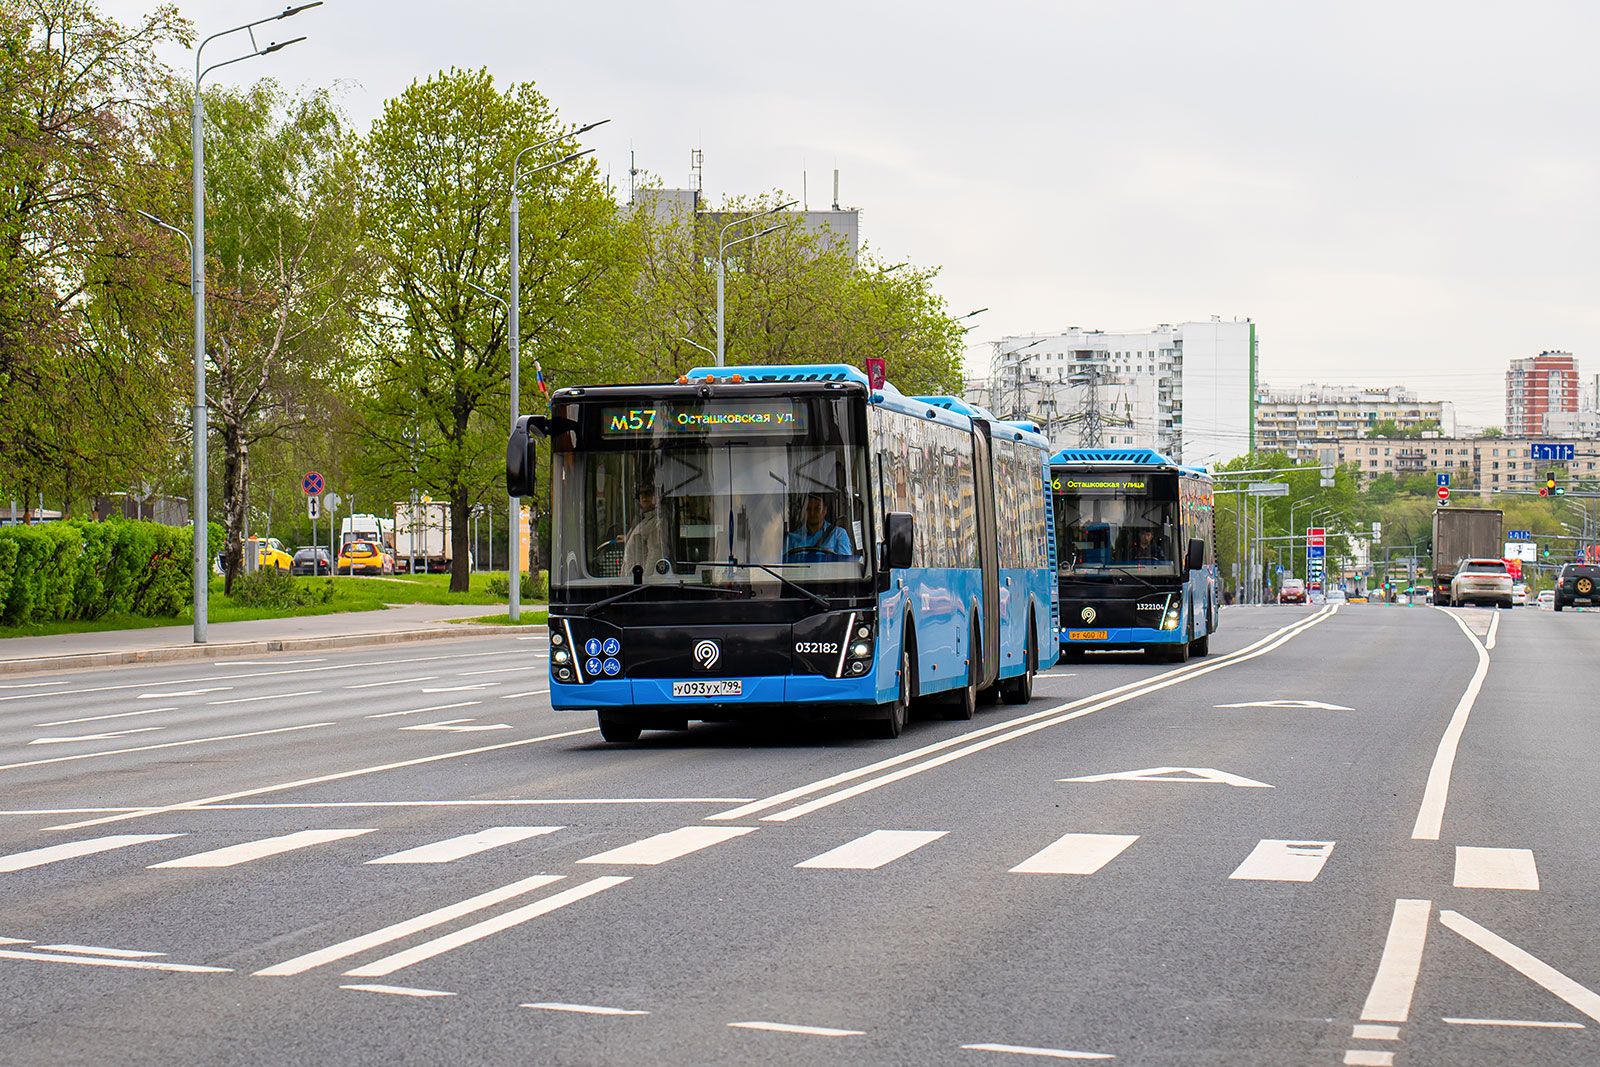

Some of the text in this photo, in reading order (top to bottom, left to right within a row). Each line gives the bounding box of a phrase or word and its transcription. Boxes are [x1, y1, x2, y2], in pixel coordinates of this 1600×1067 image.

[677, 412, 771, 426] Осташковская
[776, 412, 796, 427] ул.
[1067, 480, 1120, 489] Осташковская
[1122, 480, 1145, 489] улица
[795, 642, 839, 655] 032182
[722, 681, 739, 691] 799
